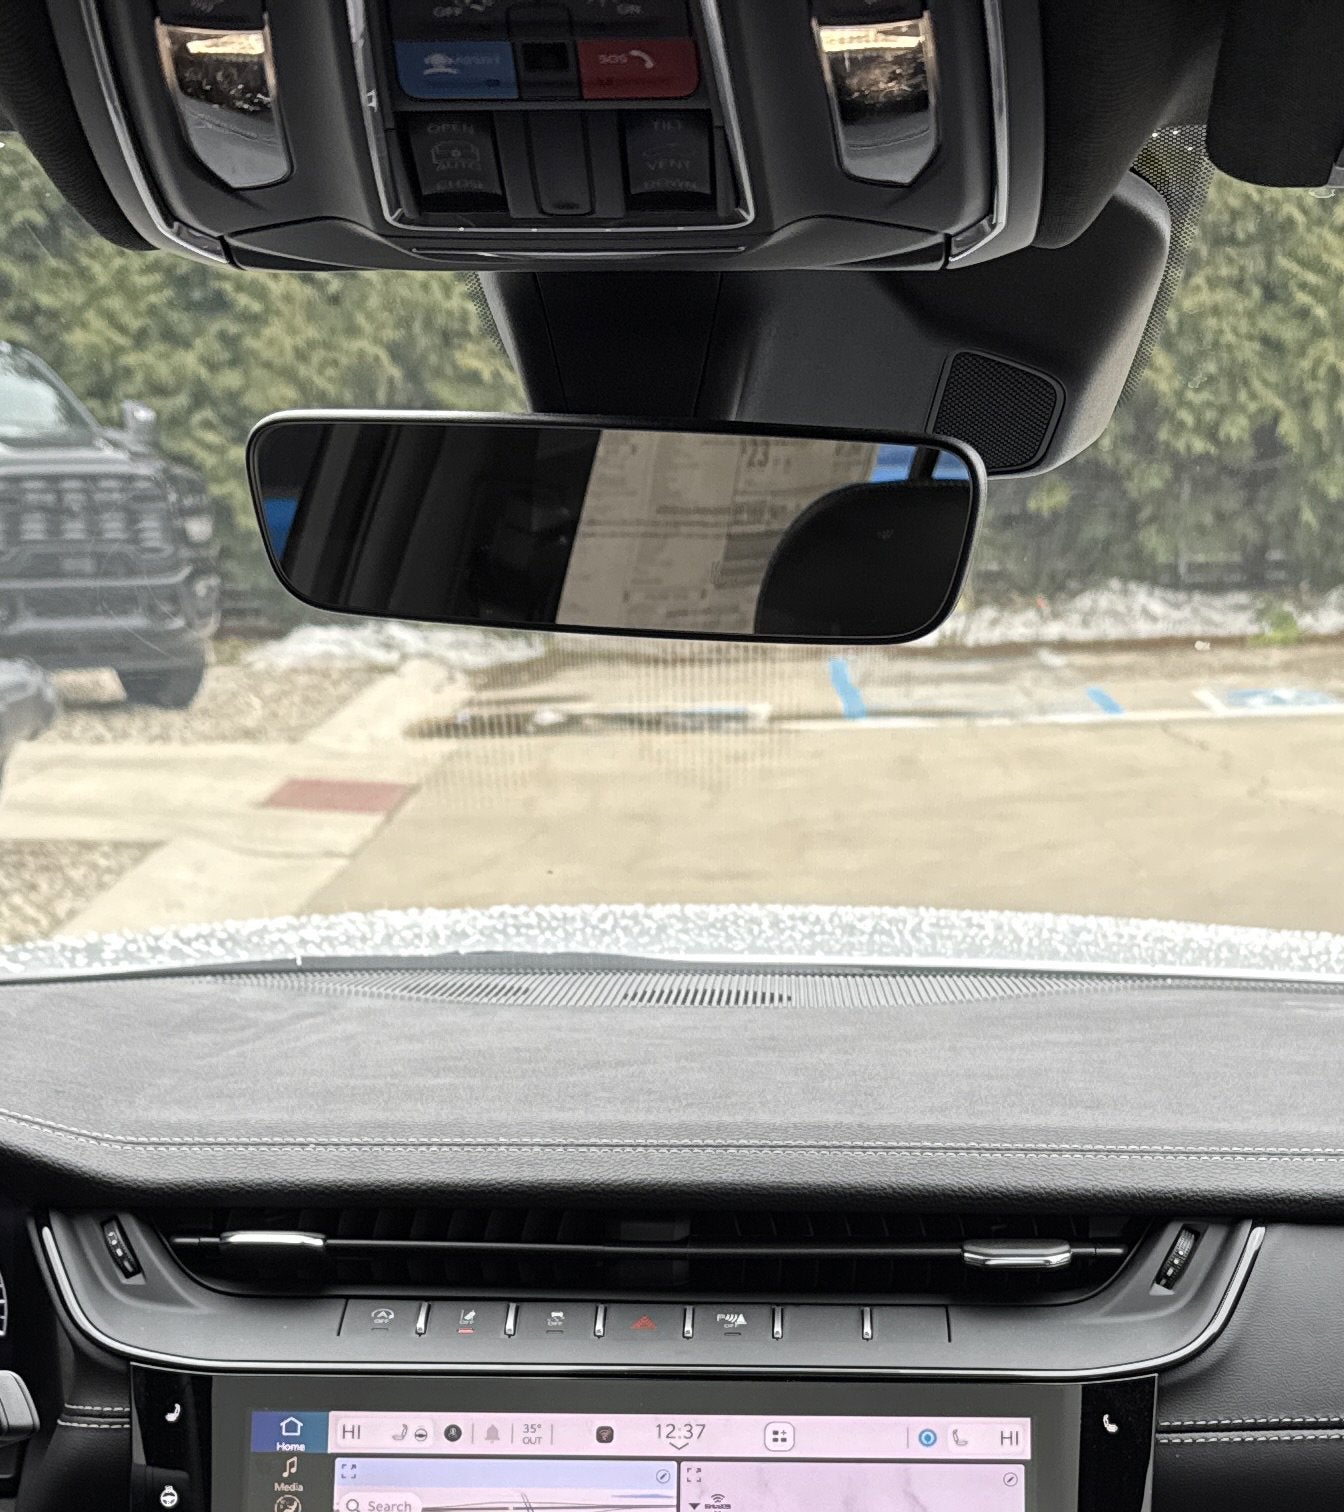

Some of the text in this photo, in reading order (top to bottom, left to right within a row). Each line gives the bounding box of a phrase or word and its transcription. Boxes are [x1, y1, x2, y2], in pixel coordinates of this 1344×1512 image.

[598, 54, 626, 65] SOS
[342, 1424, 360, 1439] HI
[522, 1423, 541, 1434] 35°
[656, 1424, 706, 1440] 12:37
[522, 1437, 542, 1445] OUT
[1000, 1432, 1019, 1446] HI
[276, 1442, 305, 1451] Home
[274, 1482, 303, 1492] Media
[368, 1501, 411, 1512] Search
